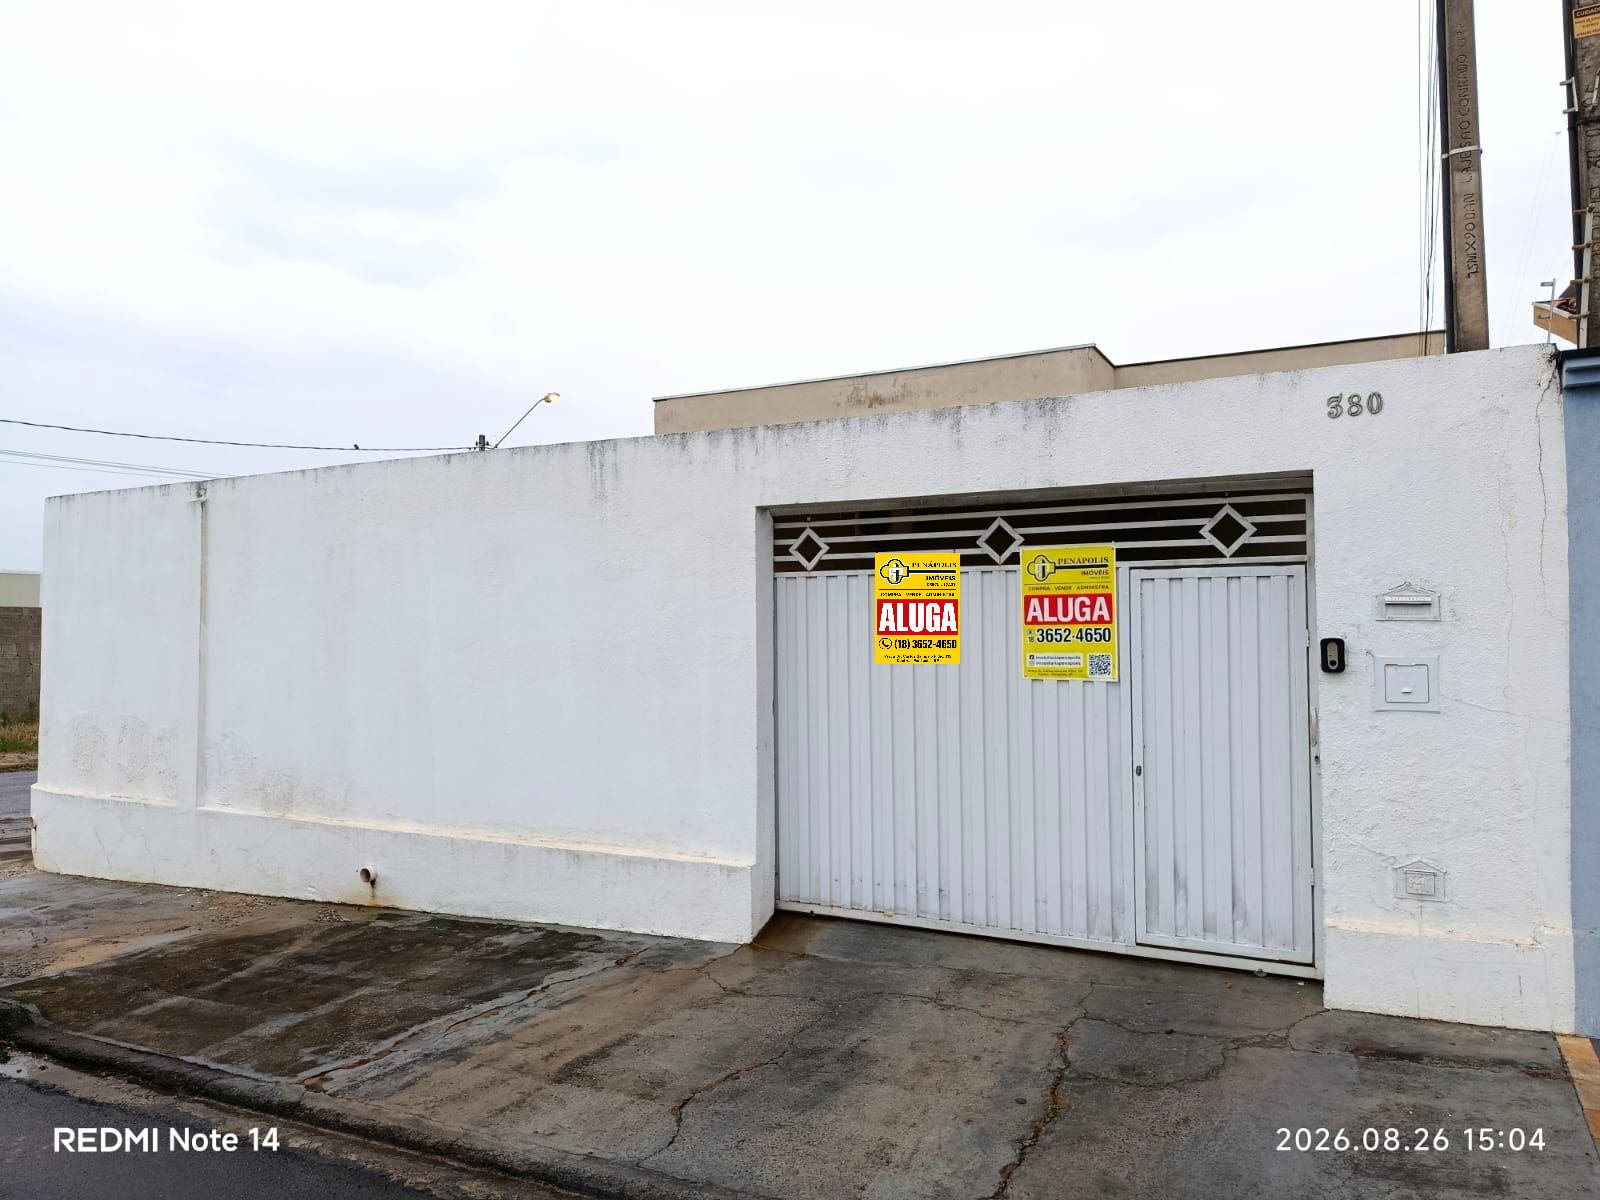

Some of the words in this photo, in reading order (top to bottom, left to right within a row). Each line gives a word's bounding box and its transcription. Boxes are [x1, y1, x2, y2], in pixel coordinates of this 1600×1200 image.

[1575, 6, 1600, 16] CUIDAD
[1456, 54, 1469, 117] CONRADO
[1326, 391, 1384, 420] 380
[878, 602, 958, 633] ALUGA
[1026, 596, 1111, 623] ALUGA
[894, 639, 911, 650] (18)
[911, 639, 957, 649] 3652-4650
